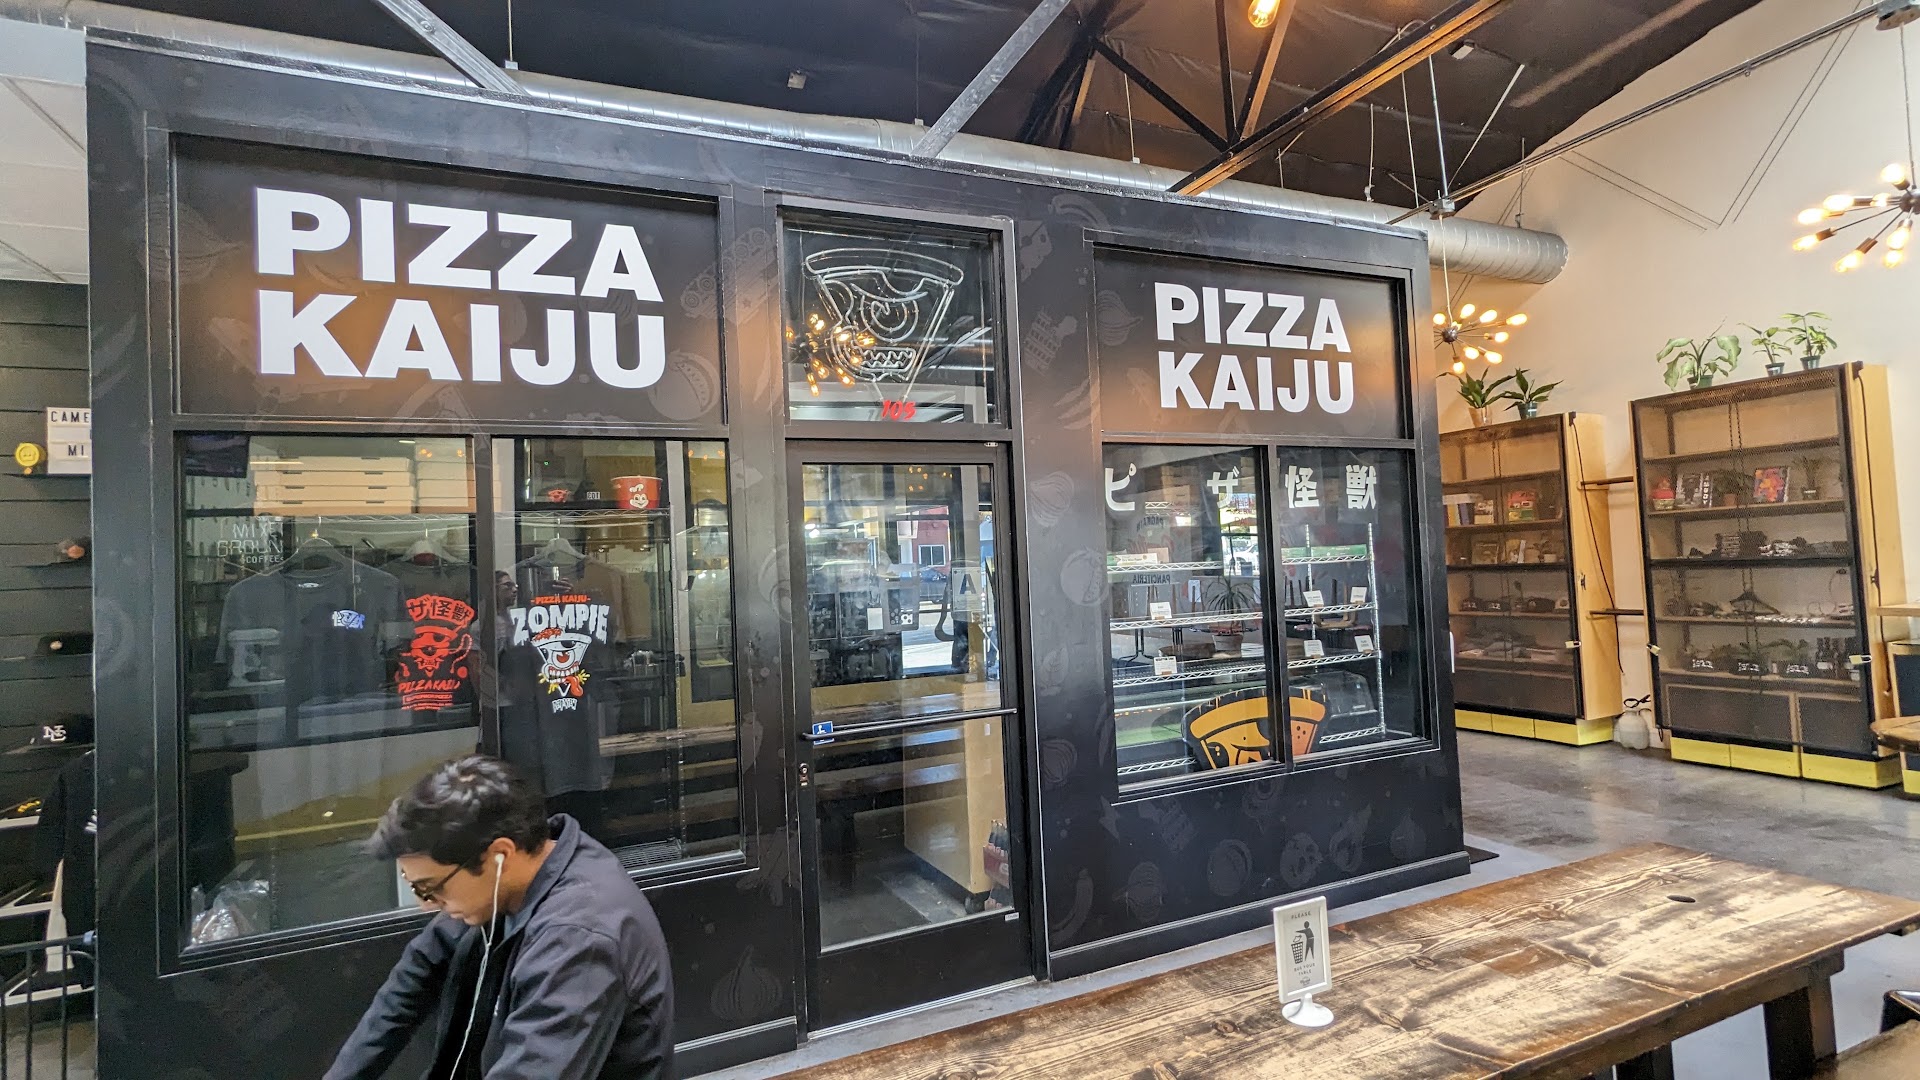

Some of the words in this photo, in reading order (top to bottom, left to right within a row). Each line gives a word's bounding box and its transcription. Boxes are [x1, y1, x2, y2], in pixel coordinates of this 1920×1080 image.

[256, 187, 664, 302] PIZZA
[258, 289, 667, 389] KAIJU
[1154, 282, 1352, 353] PIZZA
[1158, 350, 1354, 415] KAIJU
[959, 574, 976, 595] A
[510, 604, 610, 646] ZOMPIE
[1291, 910, 1312, 920] PLEASE
